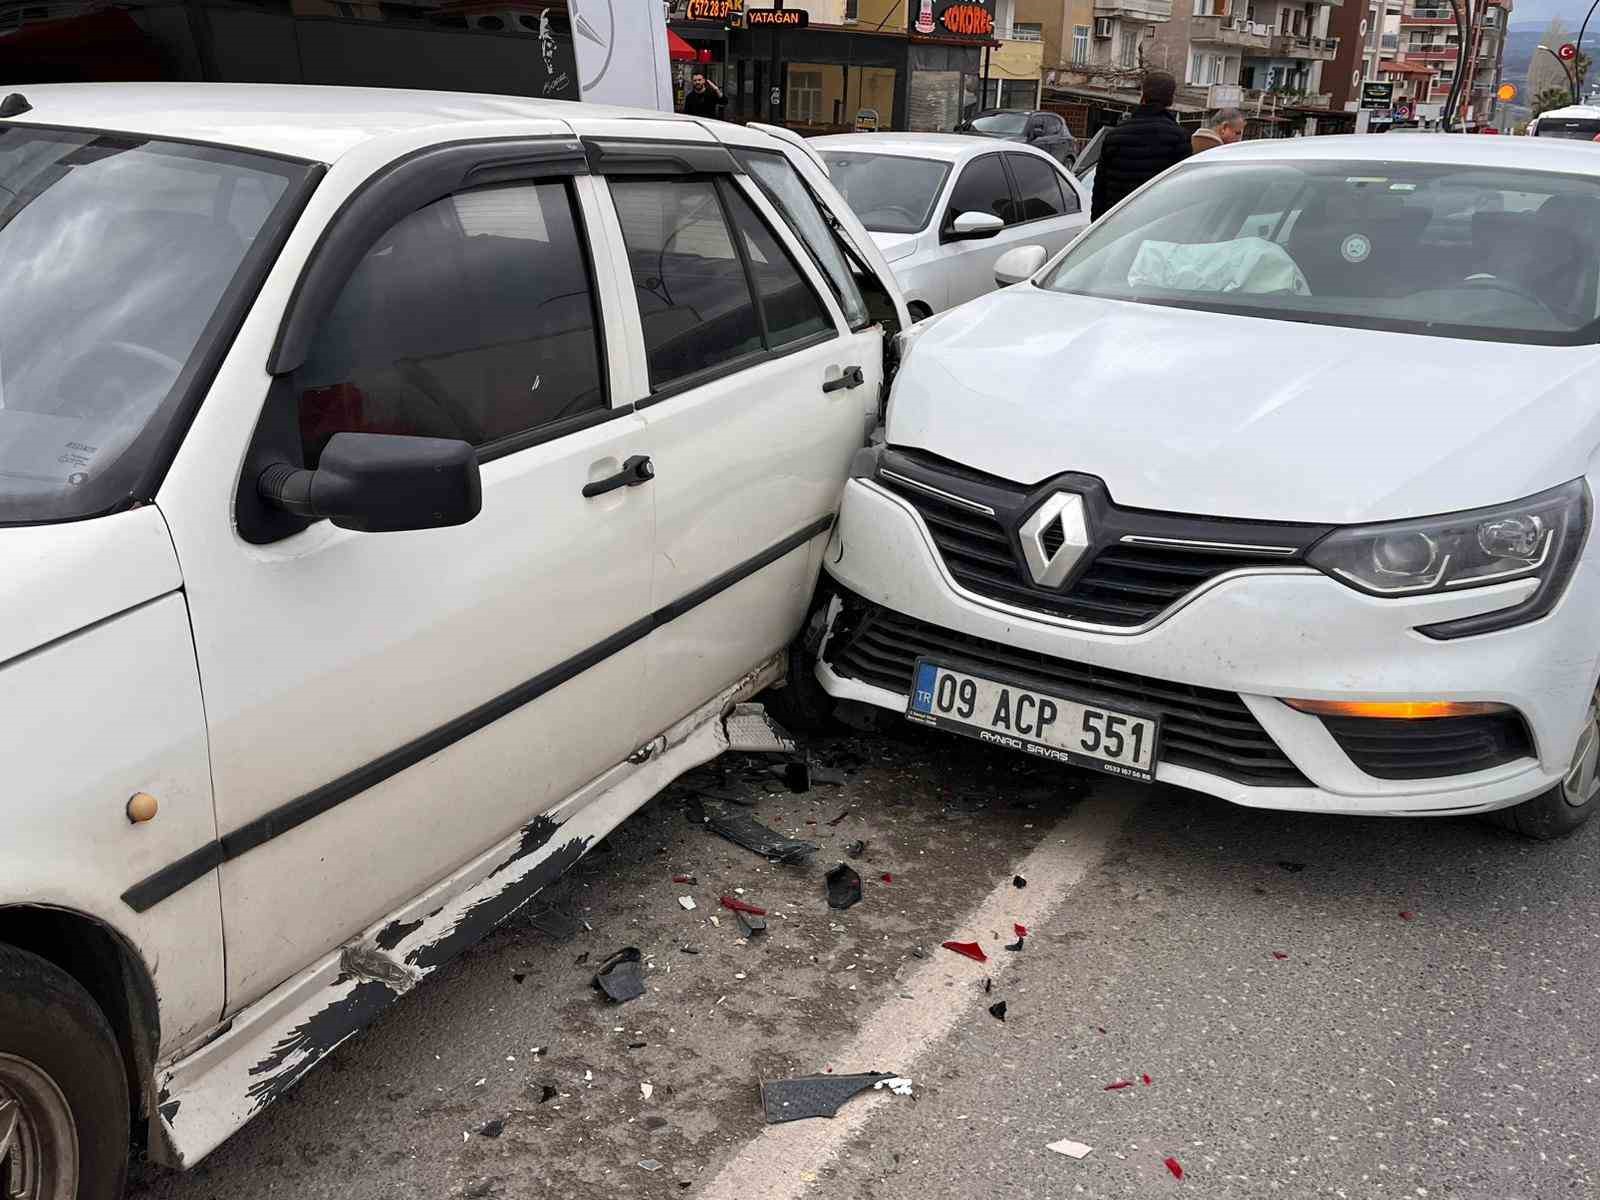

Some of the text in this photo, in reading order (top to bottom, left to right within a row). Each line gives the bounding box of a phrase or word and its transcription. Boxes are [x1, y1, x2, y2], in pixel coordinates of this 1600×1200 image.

[710, 1, 719, 16] 28
[720, 1, 729, 17] 37
[749, 10, 799, 23] YATAĞAN
[916, 690, 931, 704] TR
[937, 674, 1144, 762] 09 ACP 551
